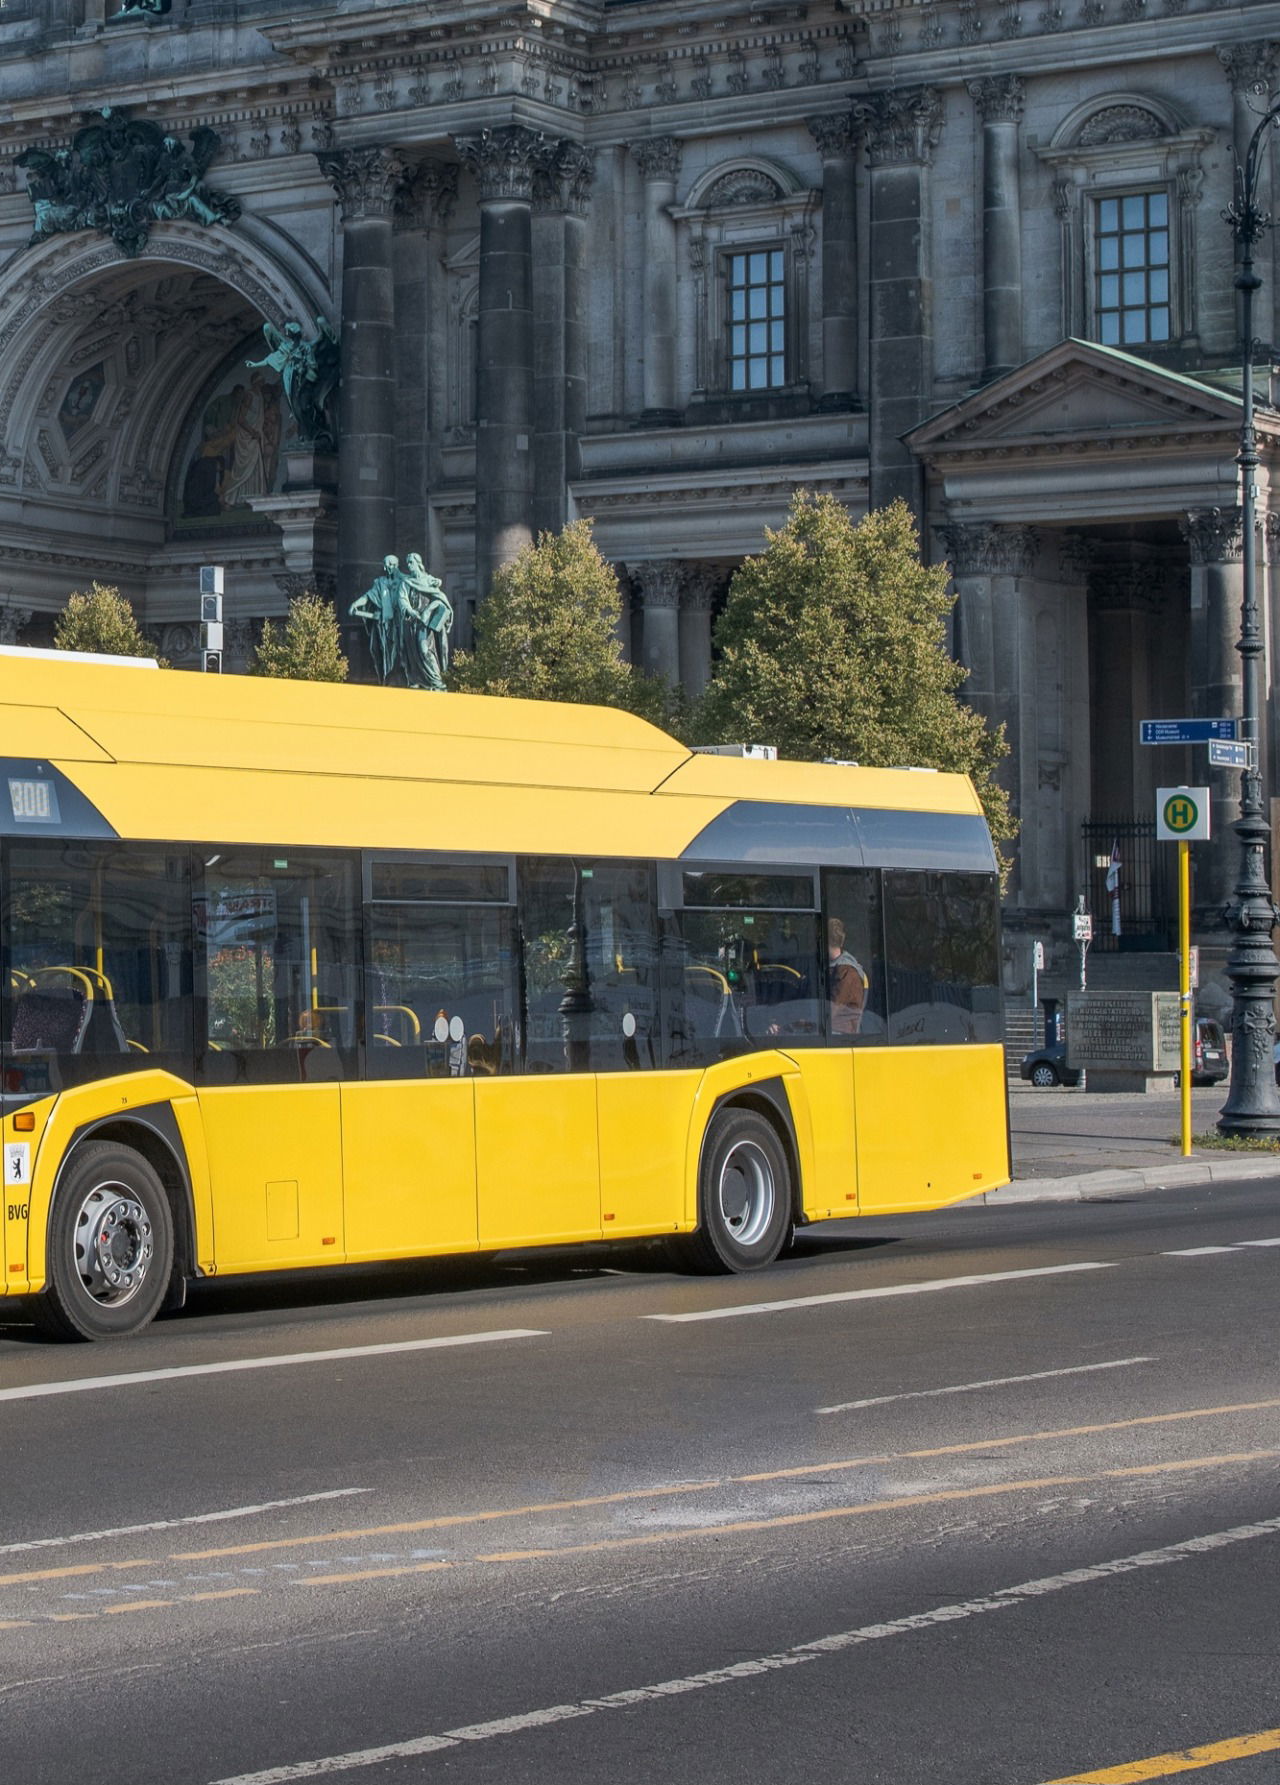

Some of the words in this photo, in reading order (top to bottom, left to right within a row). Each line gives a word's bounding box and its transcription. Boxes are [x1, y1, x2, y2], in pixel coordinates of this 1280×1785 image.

[11, 782, 51, 816] 300
[1172, 803, 1188, 824] H
[8, 1203, 28, 1221] BVG
